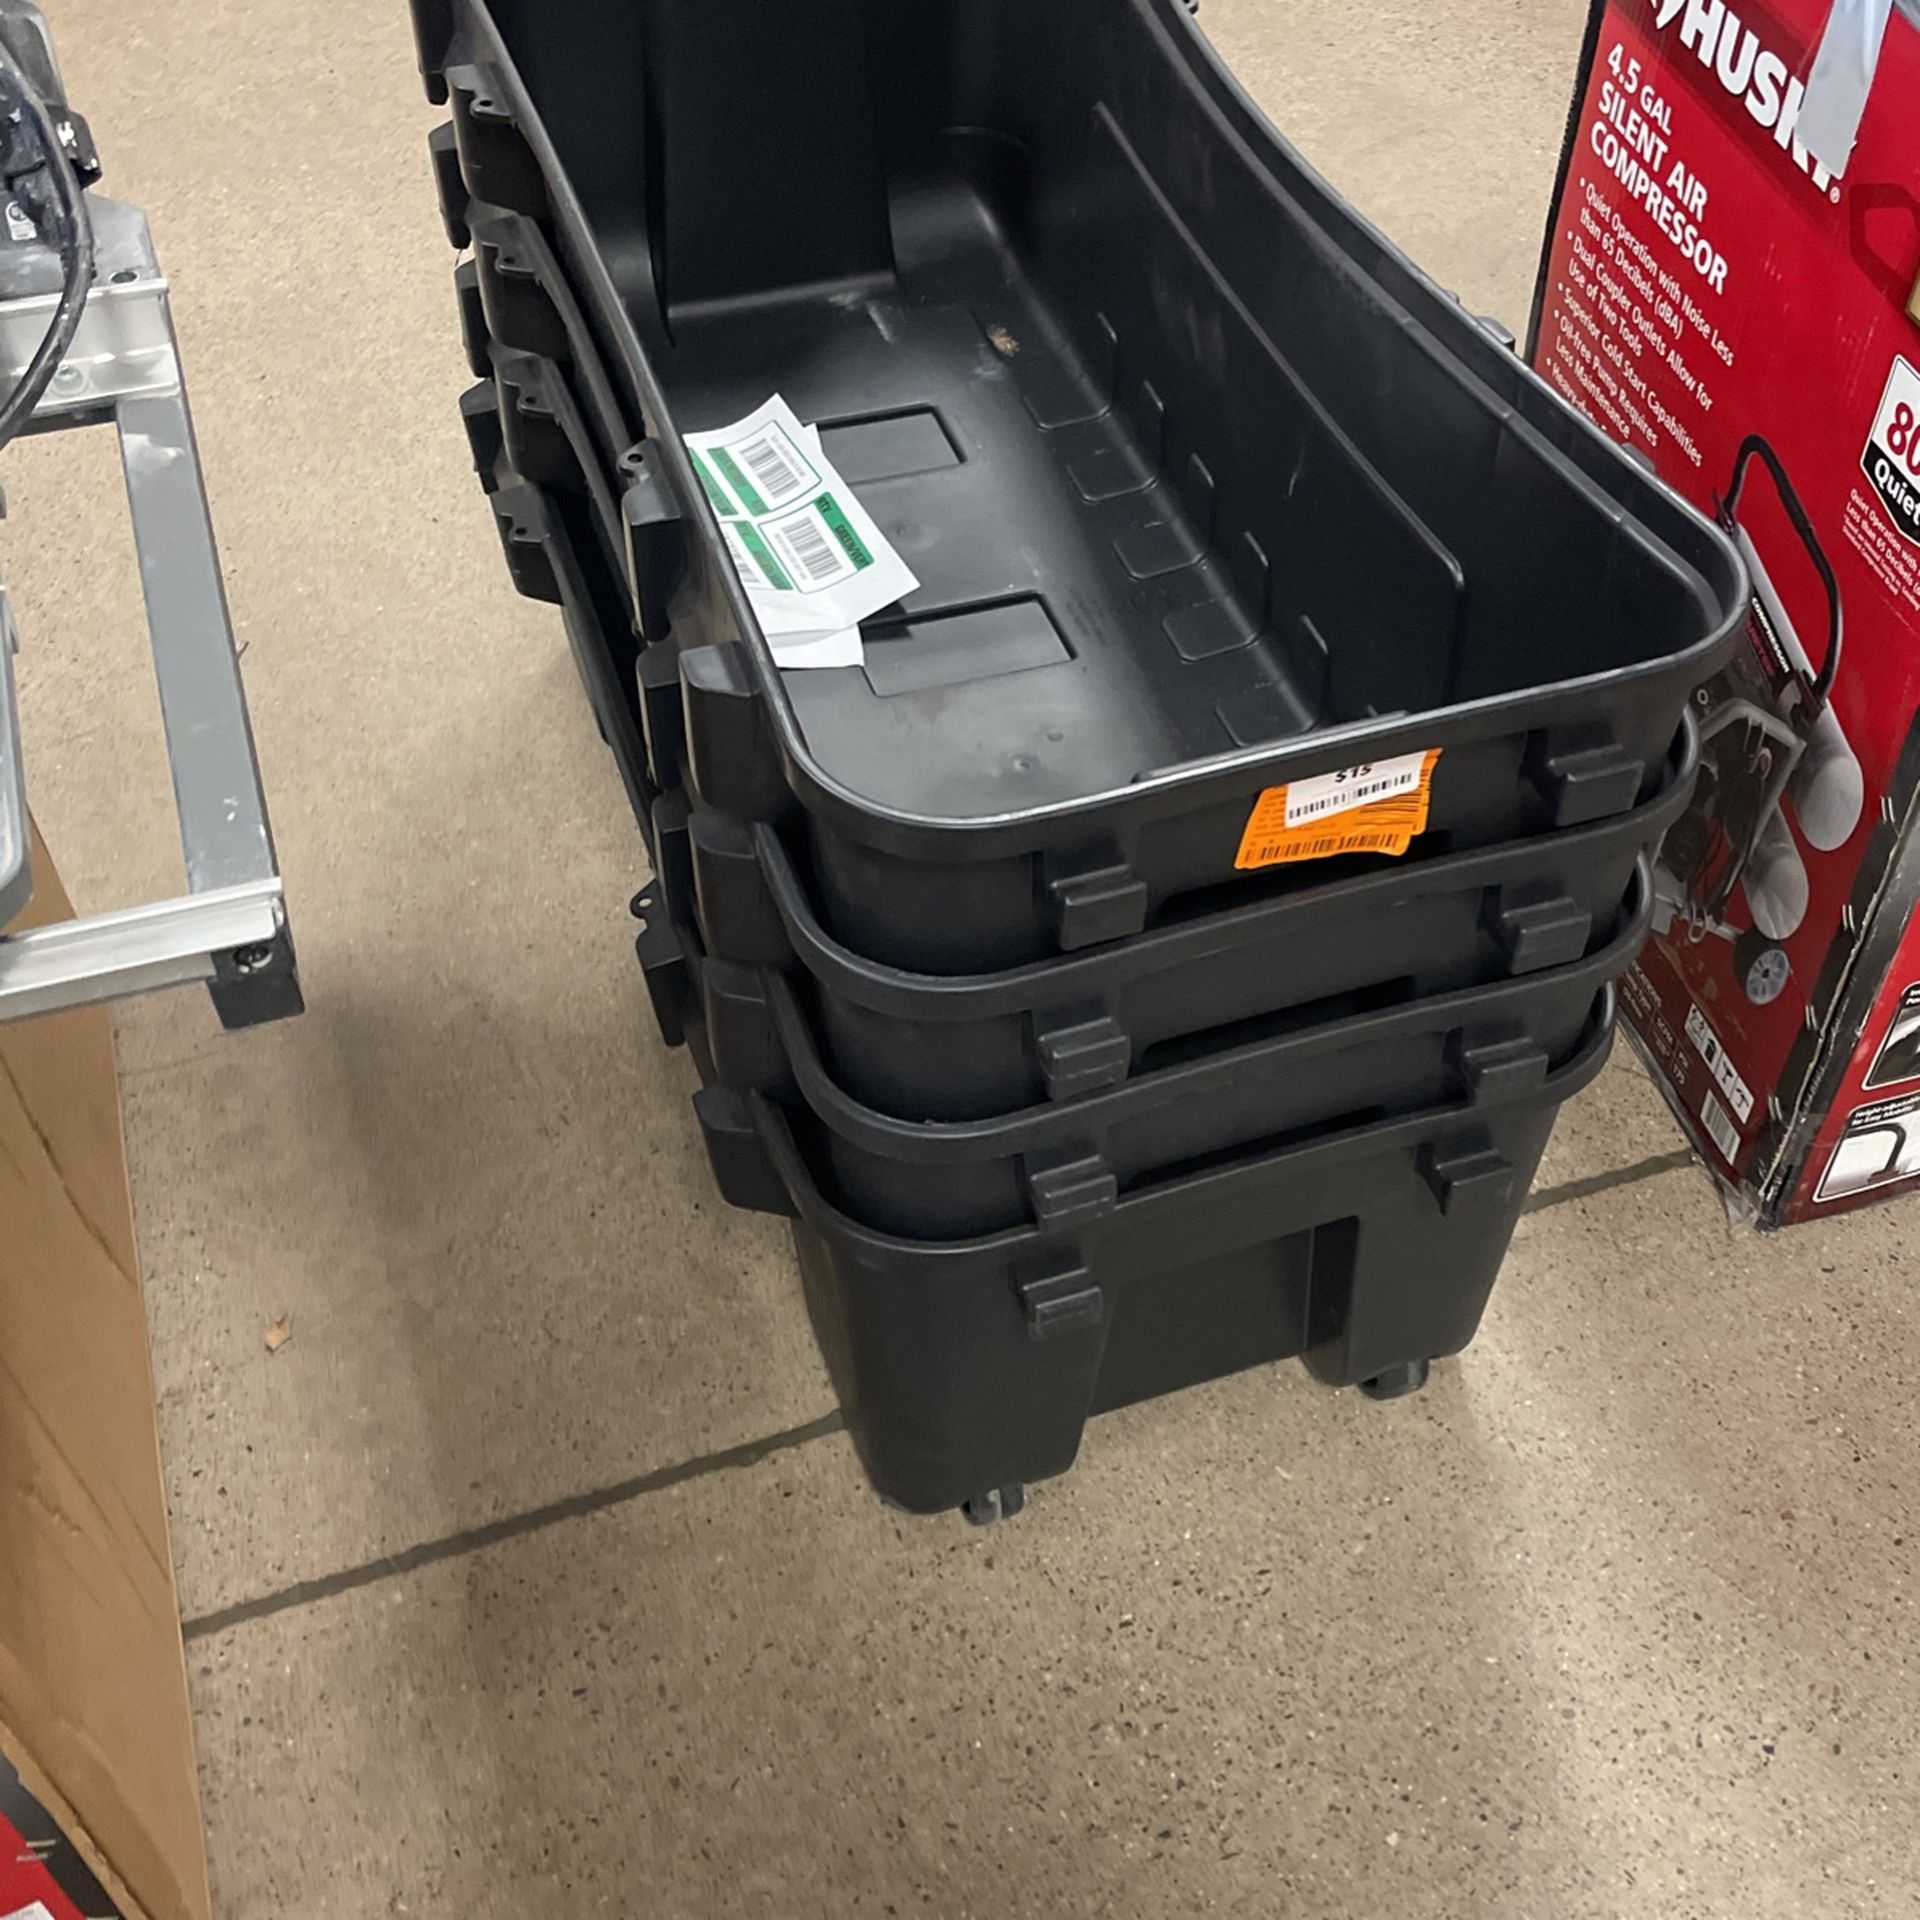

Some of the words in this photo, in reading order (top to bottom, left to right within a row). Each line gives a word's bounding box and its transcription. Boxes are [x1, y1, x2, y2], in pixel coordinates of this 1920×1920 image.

[1598, 80, 1669, 173] SILENT
[1666, 160, 1708, 223] AIR
[1607, 43, 1641, 94] 4.5
[1640, 84, 1672, 136] GAL
[1679, 0, 1832, 193] HUSK
[1580, 207, 1601, 242] than
[1602, 232, 1615, 256] 65
[1615, 247, 1655, 304] Decibels
[1654, 294, 1683, 340] (dBA)
[1586, 183, 1611, 222] Quiet
[1611, 213, 1658, 277] Operation
[1659, 269, 1681, 304] with
[1682, 295, 1711, 339] Noise
[1711, 329, 1735, 367] Less
[1591, 121, 1728, 295] COMPRESSOR
[1564, 287, 1601, 341] Superior
[1601, 334, 1624, 368] Cold
[1623, 360, 1647, 398] Start
[1647, 391, 1702, 467] Capabilities
[1568, 258, 1585, 288] Use
[1586, 284, 1598, 302] of
[1598, 292, 1617, 326] Two
[1618, 317, 1643, 357] Tools
[1573, 235, 1596, 270] Dual
[1596, 263, 1632, 312] Coupler
[1632, 306, 1667, 356] Outlets
[1666, 349, 1696, 392] Allow
[1695, 382, 1713, 412] for
[1556, 336, 1574, 367] Less
[1574, 360, 1631, 439] Maintenance
[1560, 315, 1592, 364] Oil-free
[1592, 355, 1618, 397] Pump
[1618, 389, 1658, 447] Requires
